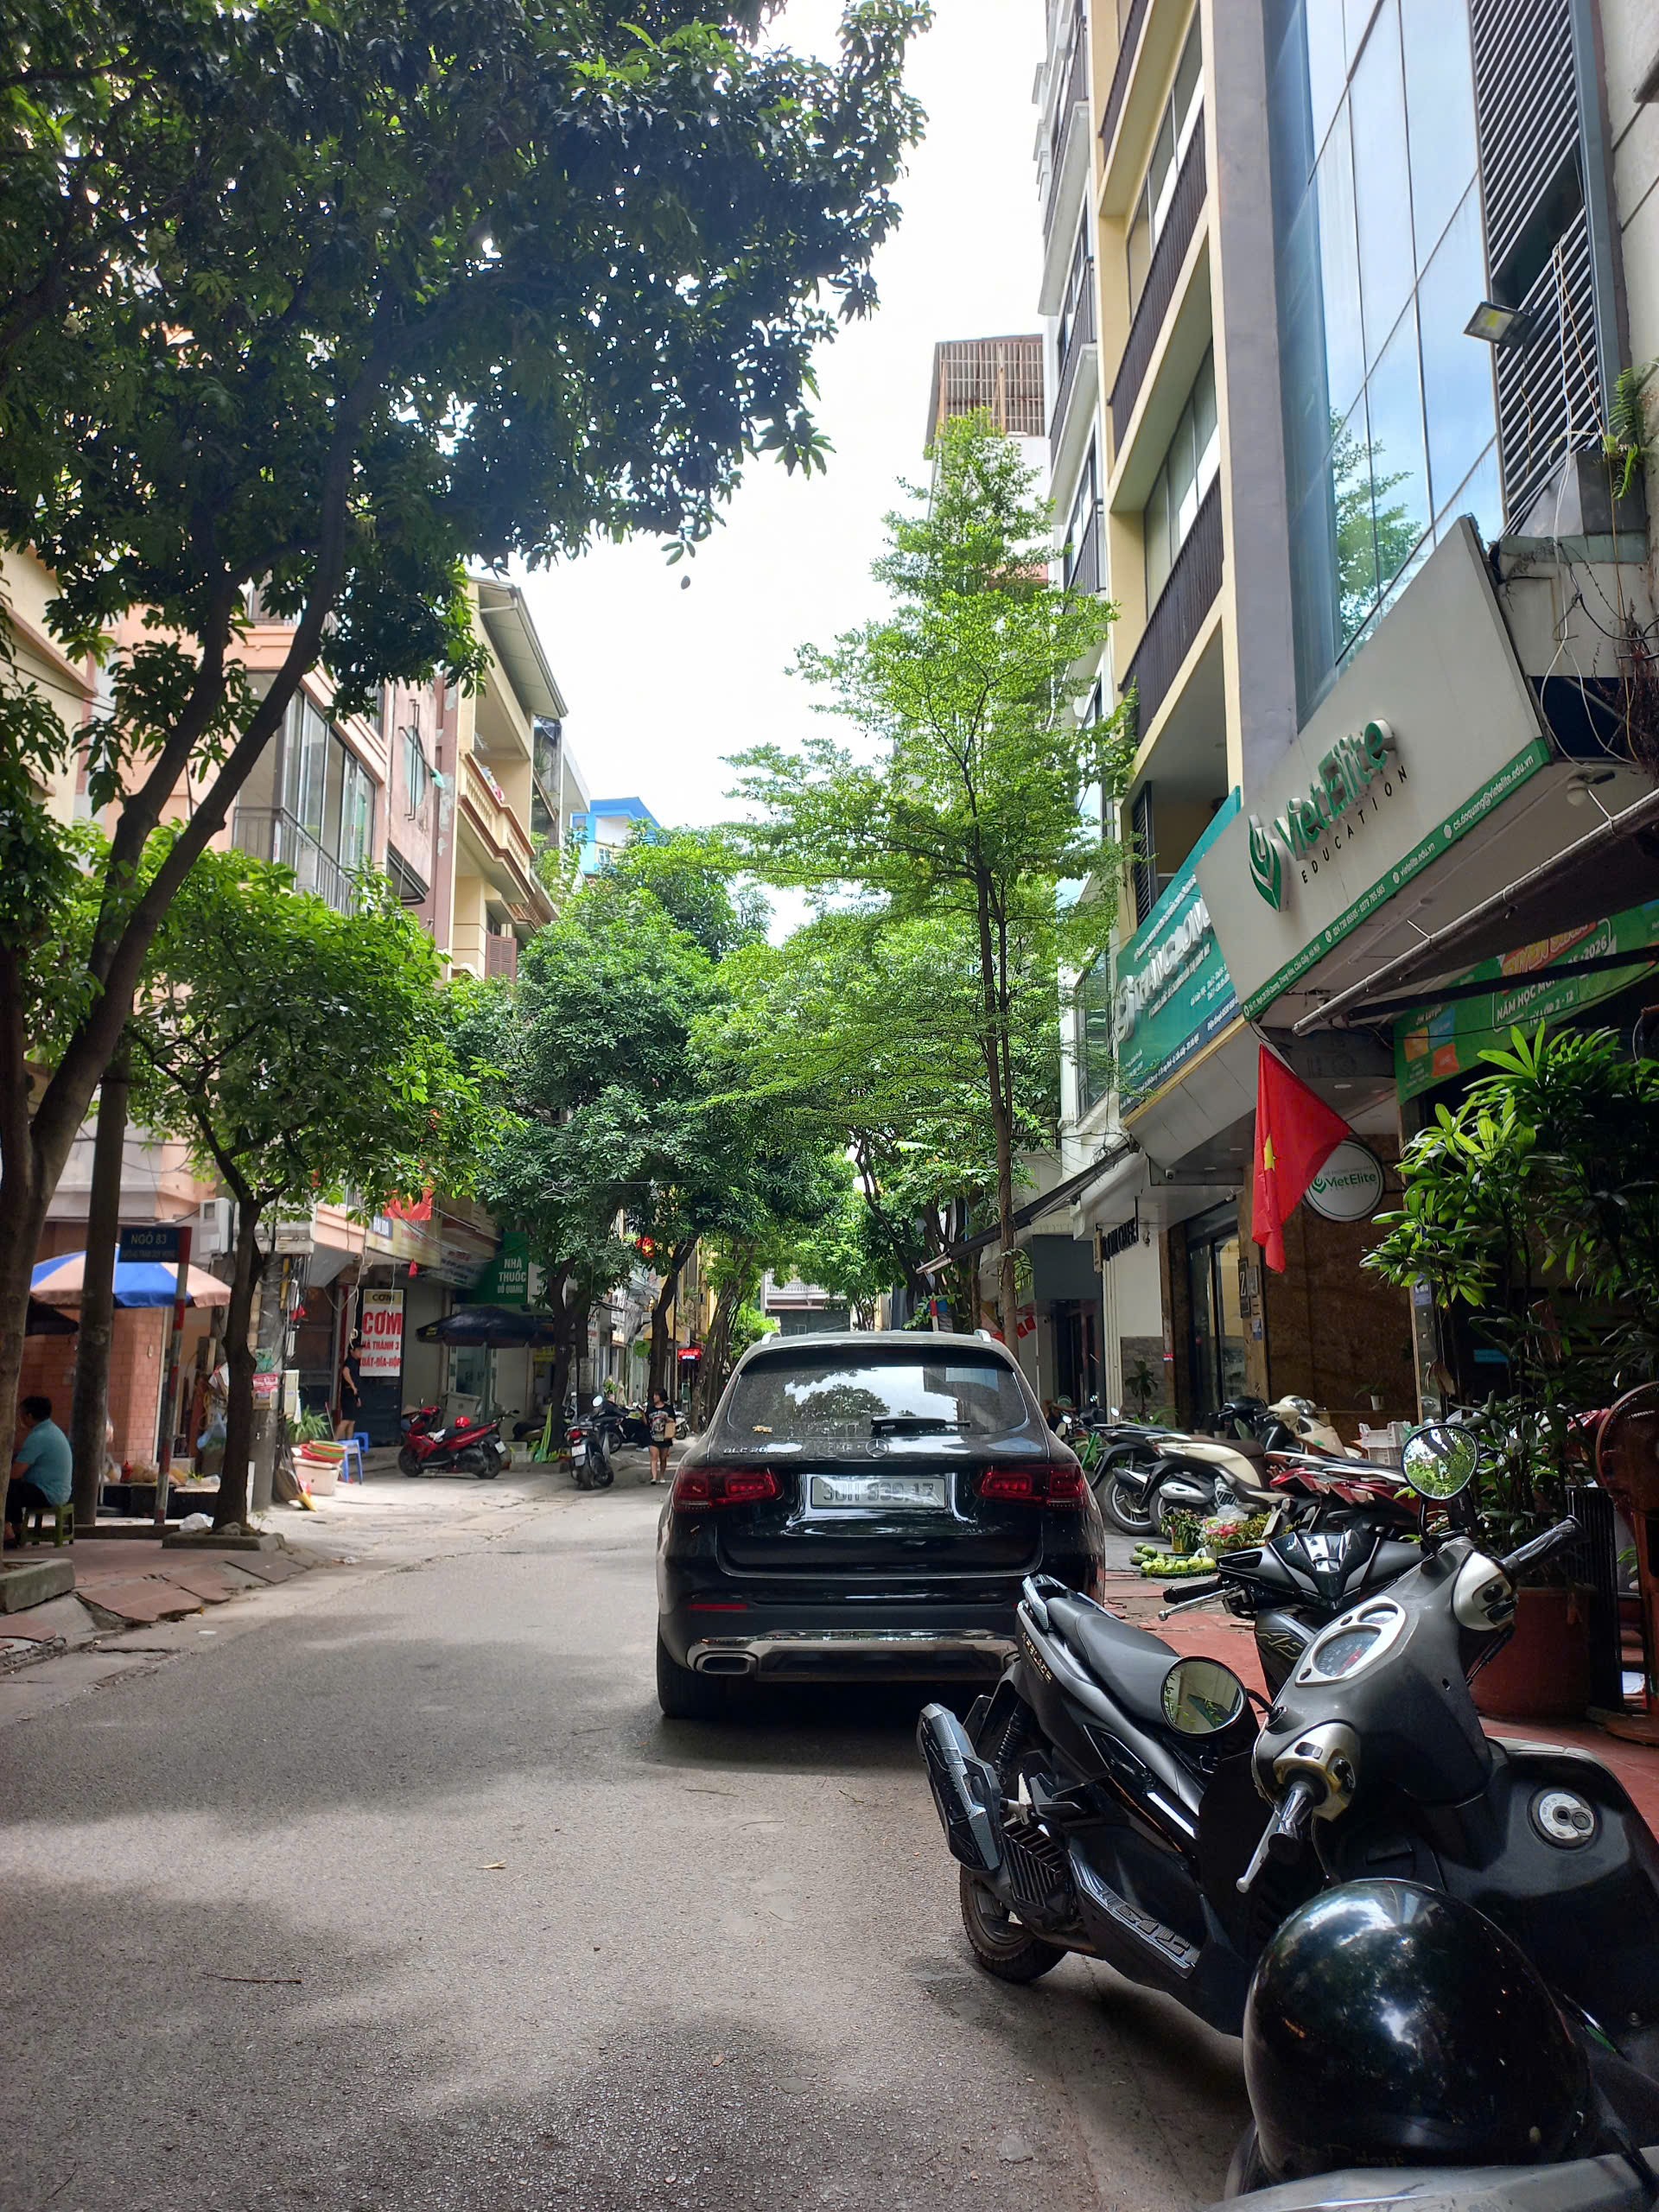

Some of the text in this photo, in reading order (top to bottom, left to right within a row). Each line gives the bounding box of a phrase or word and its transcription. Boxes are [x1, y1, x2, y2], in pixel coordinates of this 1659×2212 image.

[1274, 720, 1394, 860] VietElite
[1301, 766, 1408, 884] EDUCATION
[1325, 1173, 1376, 1187] VietElite
[504, 1256, 522, 1268] NHÀ
[499, 1270, 526, 1282] THUỐC
[363, 1310, 403, 1336] CƠM
[372, 1339, 394, 1350] THÀNH
